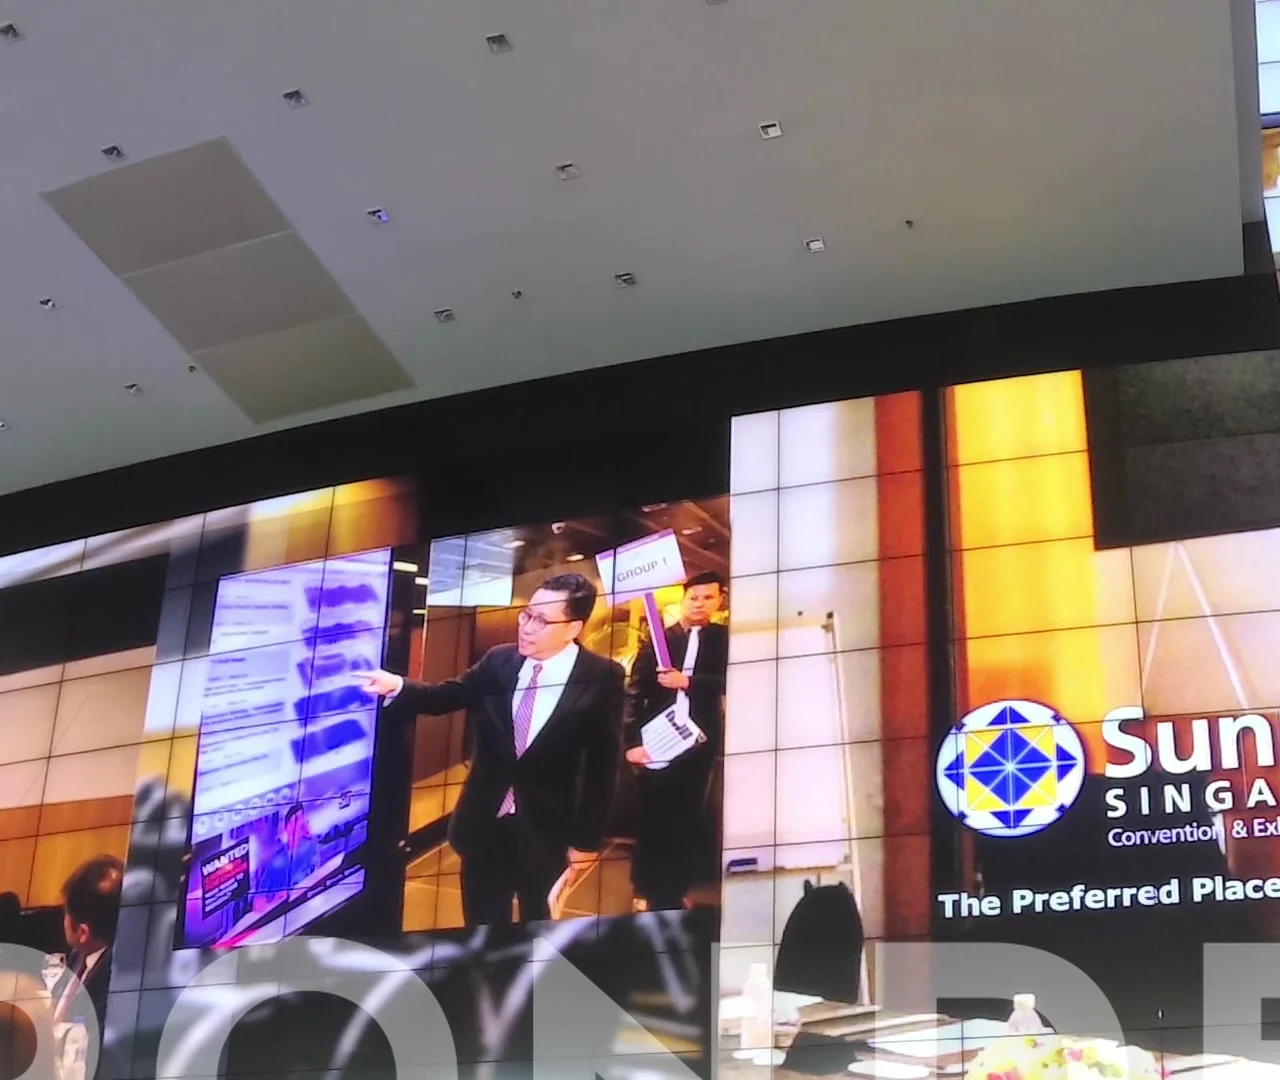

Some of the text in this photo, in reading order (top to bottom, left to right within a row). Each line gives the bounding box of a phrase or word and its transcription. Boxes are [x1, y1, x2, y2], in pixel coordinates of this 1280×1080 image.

[616, 561, 658, 583] GROUP
[1108, 822, 1222, 847] Convention
[1231, 821, 1248, 838] &
[938, 892, 1001, 918] The
[1013, 880, 1180, 912] Preferred
